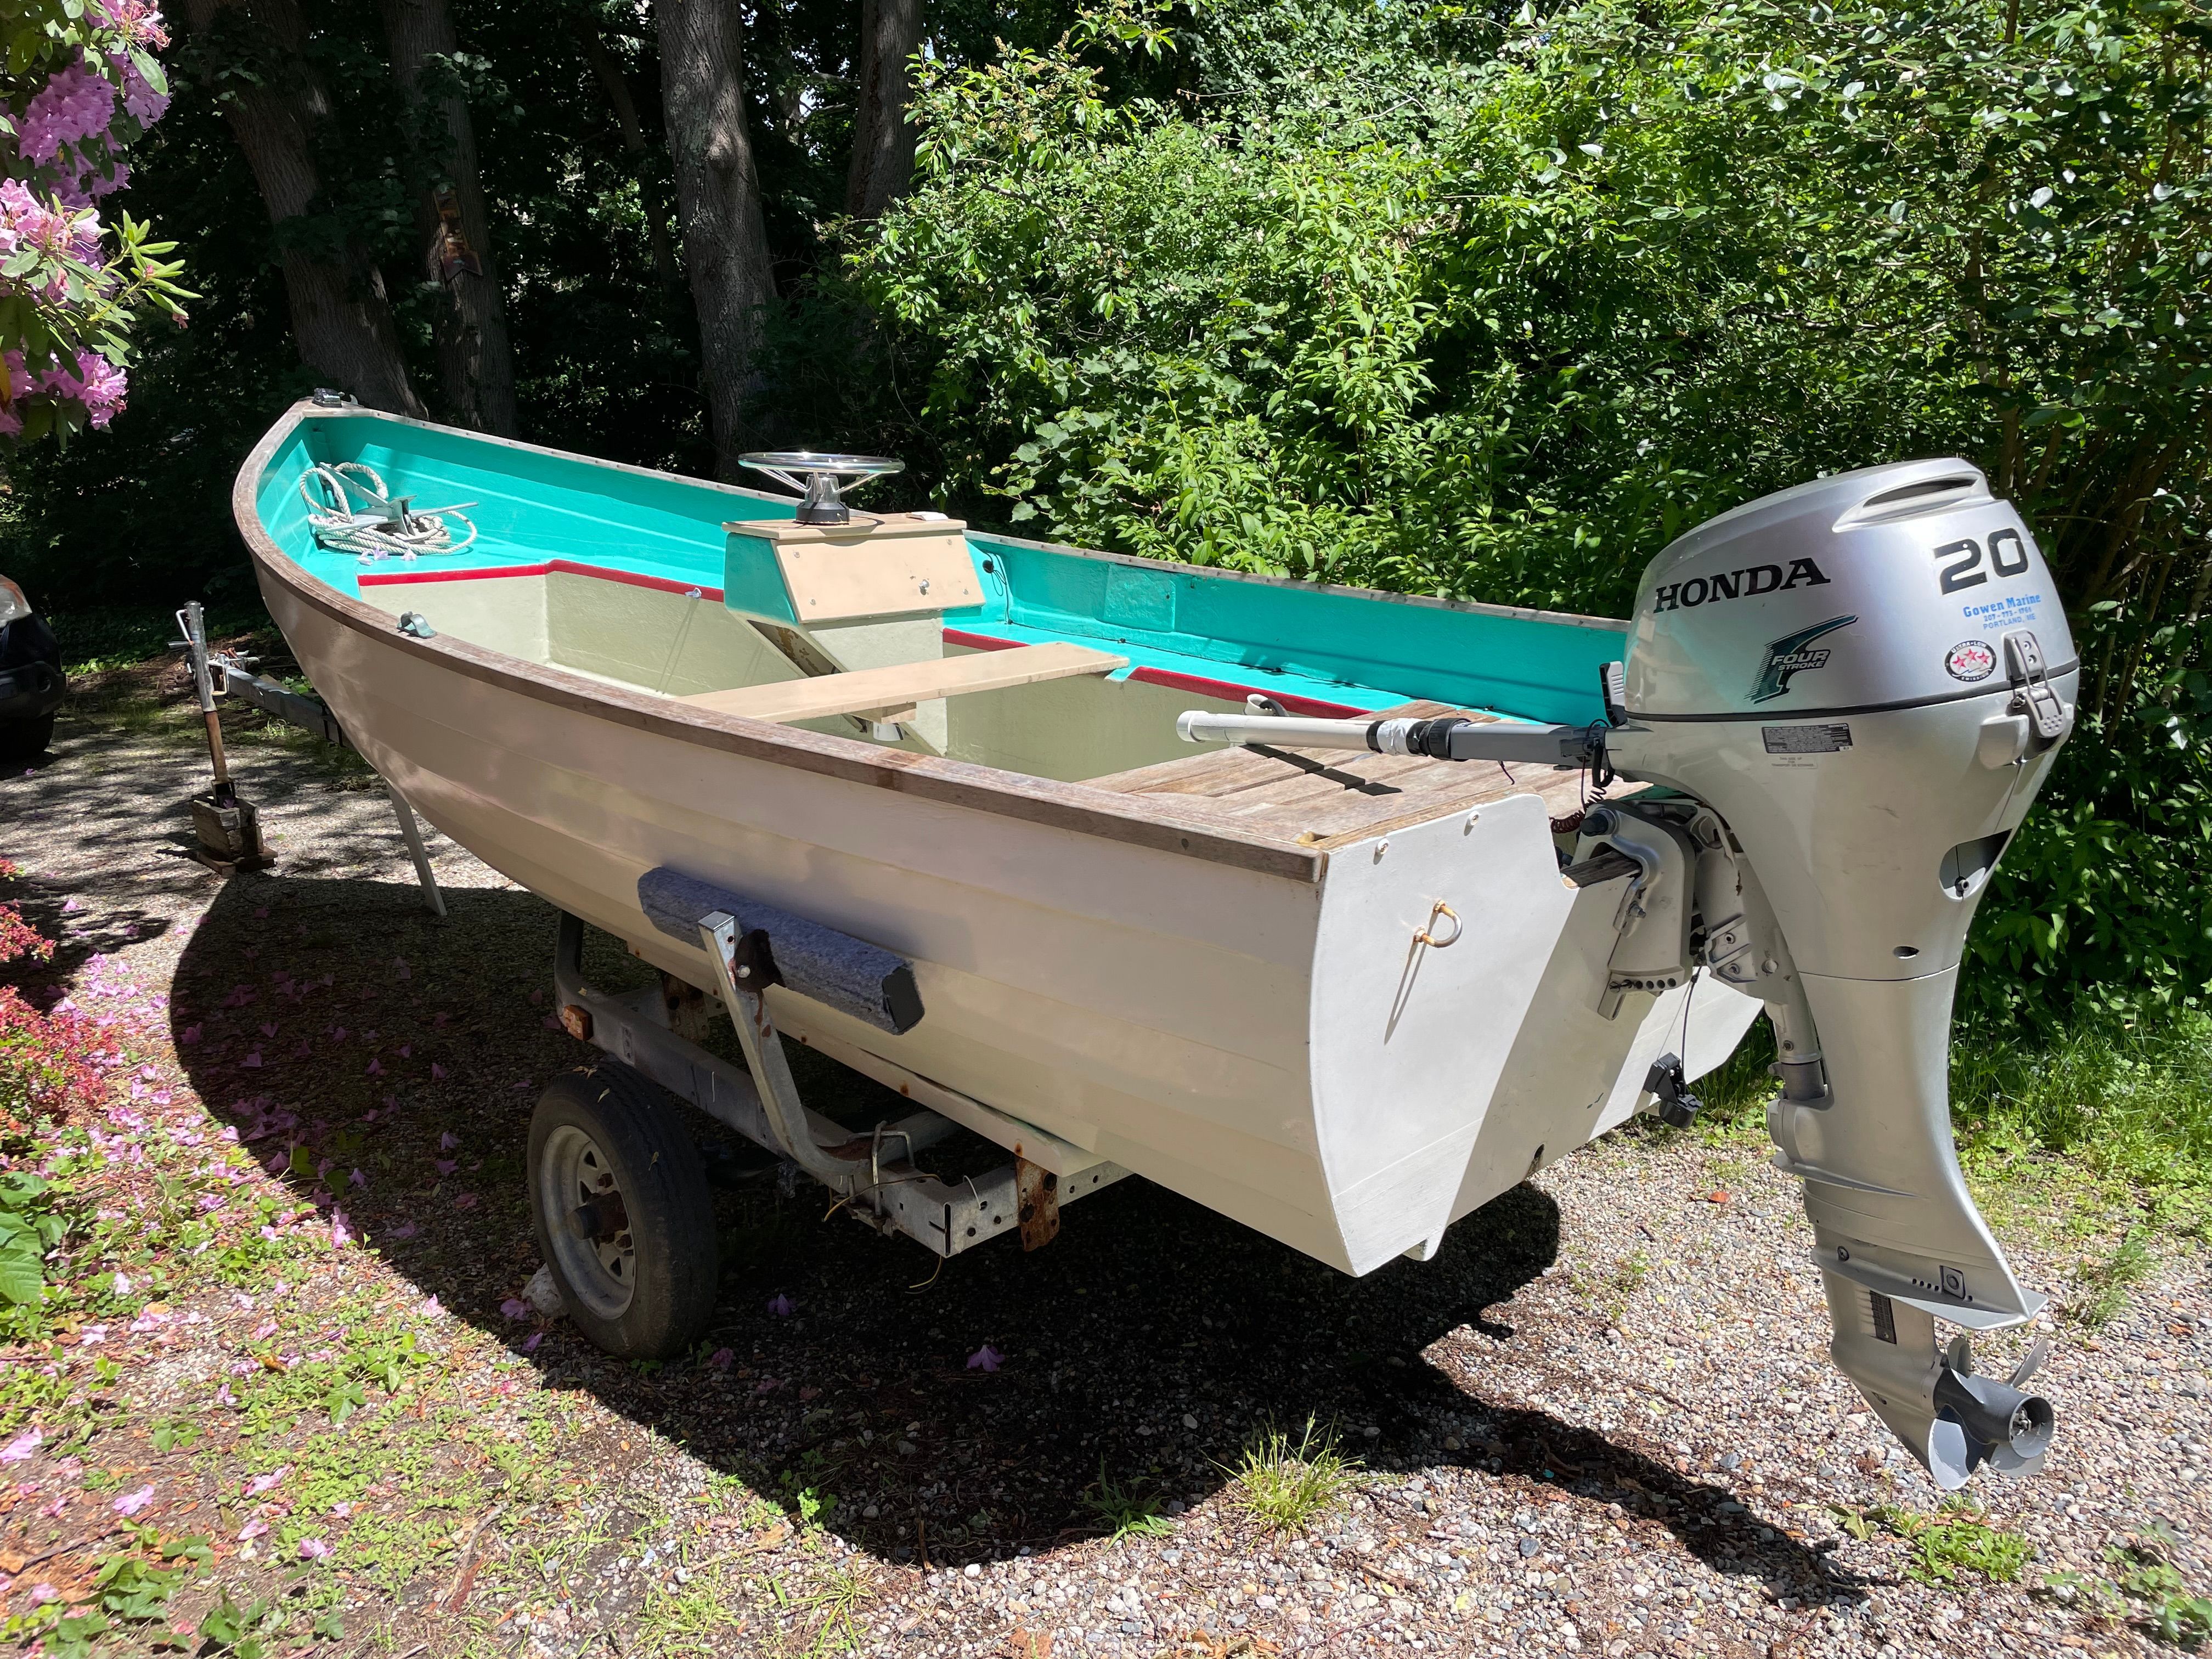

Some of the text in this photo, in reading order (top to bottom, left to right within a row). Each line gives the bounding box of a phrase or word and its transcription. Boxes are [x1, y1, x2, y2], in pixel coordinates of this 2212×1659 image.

[1933, 528, 2028, 595] 20
[1653, 557, 1831, 613] HONDA
[1963, 594, 2041, 617] Gowen Marine
[1983, 616, 2024, 630] PORTLAND,
[1771, 651, 1829, 665] FOUR
[1778, 661, 1825, 671] STROKE
